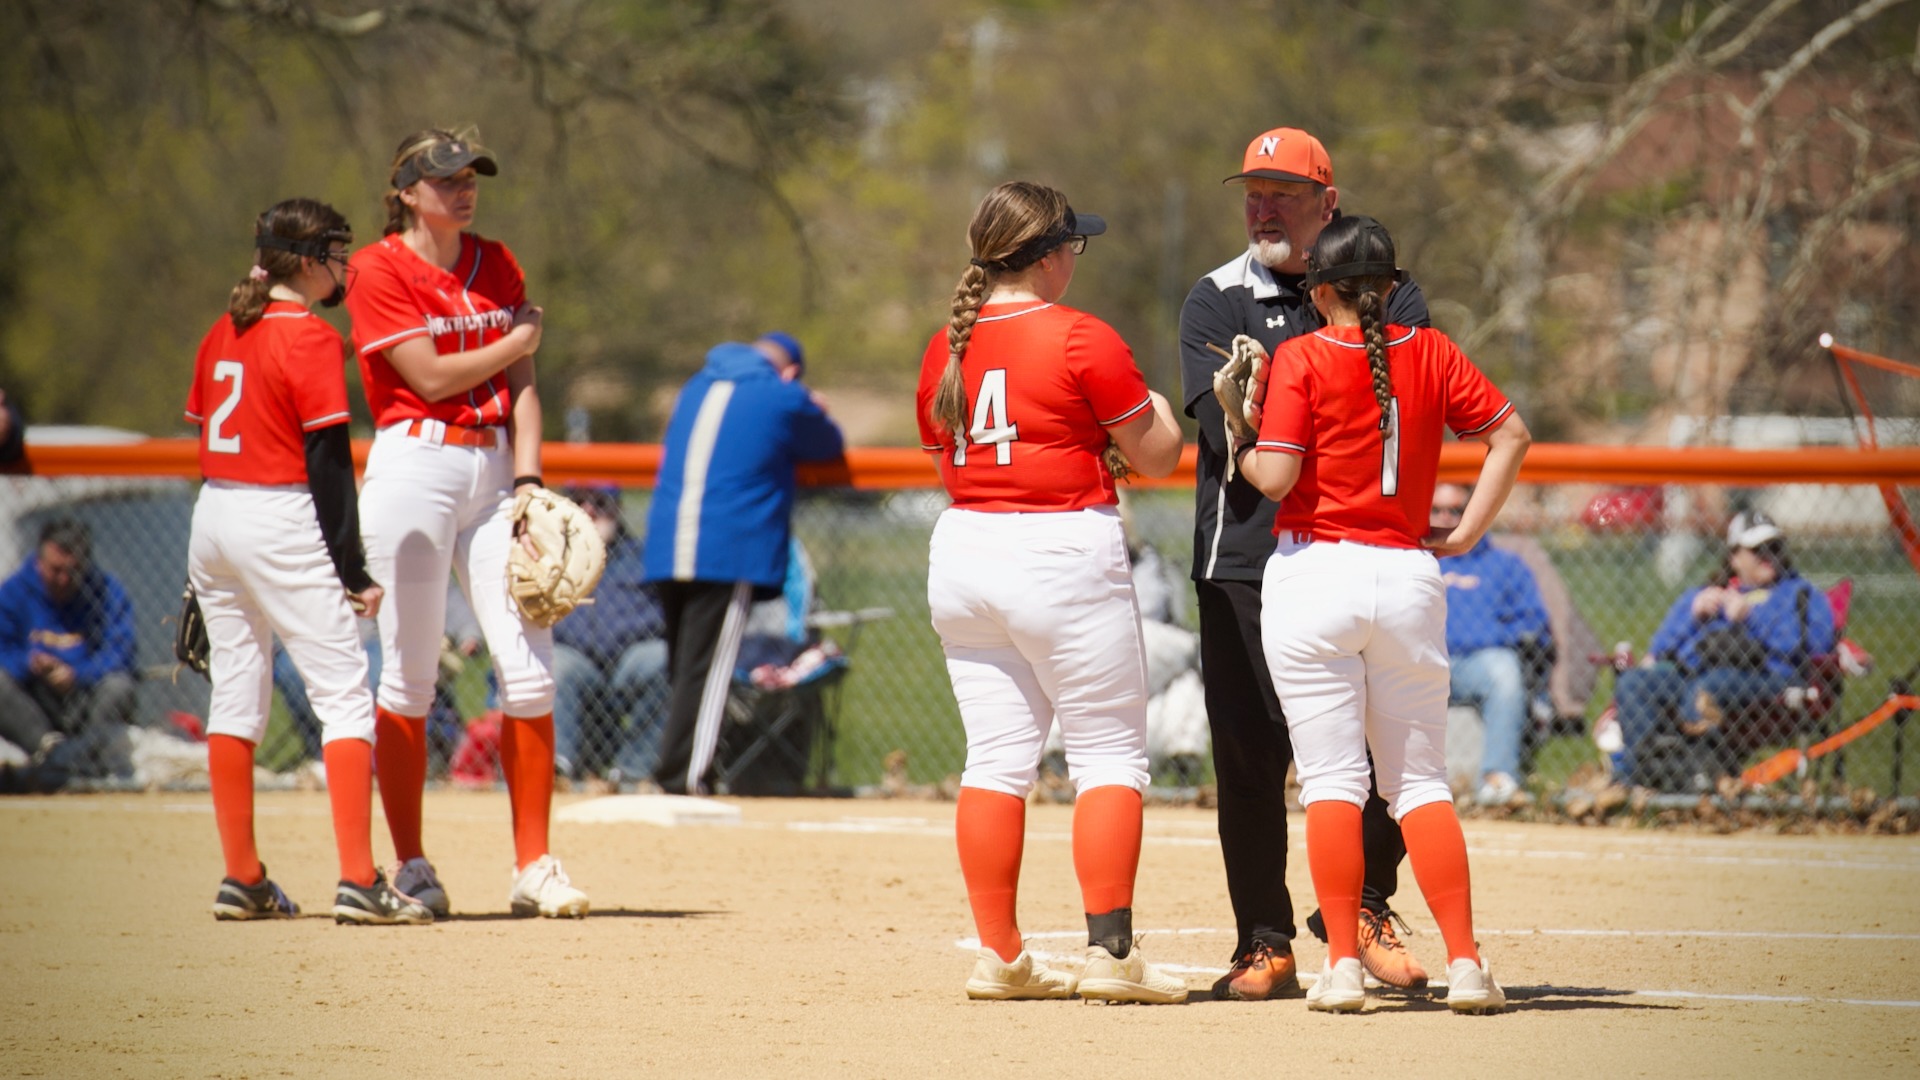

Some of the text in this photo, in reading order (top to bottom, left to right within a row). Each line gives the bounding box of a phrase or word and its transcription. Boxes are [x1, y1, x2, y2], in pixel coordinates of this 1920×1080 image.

[1256, 137, 1283, 161] N
[208, 360, 243, 454] 2
[1379, 396, 1400, 496] 1
